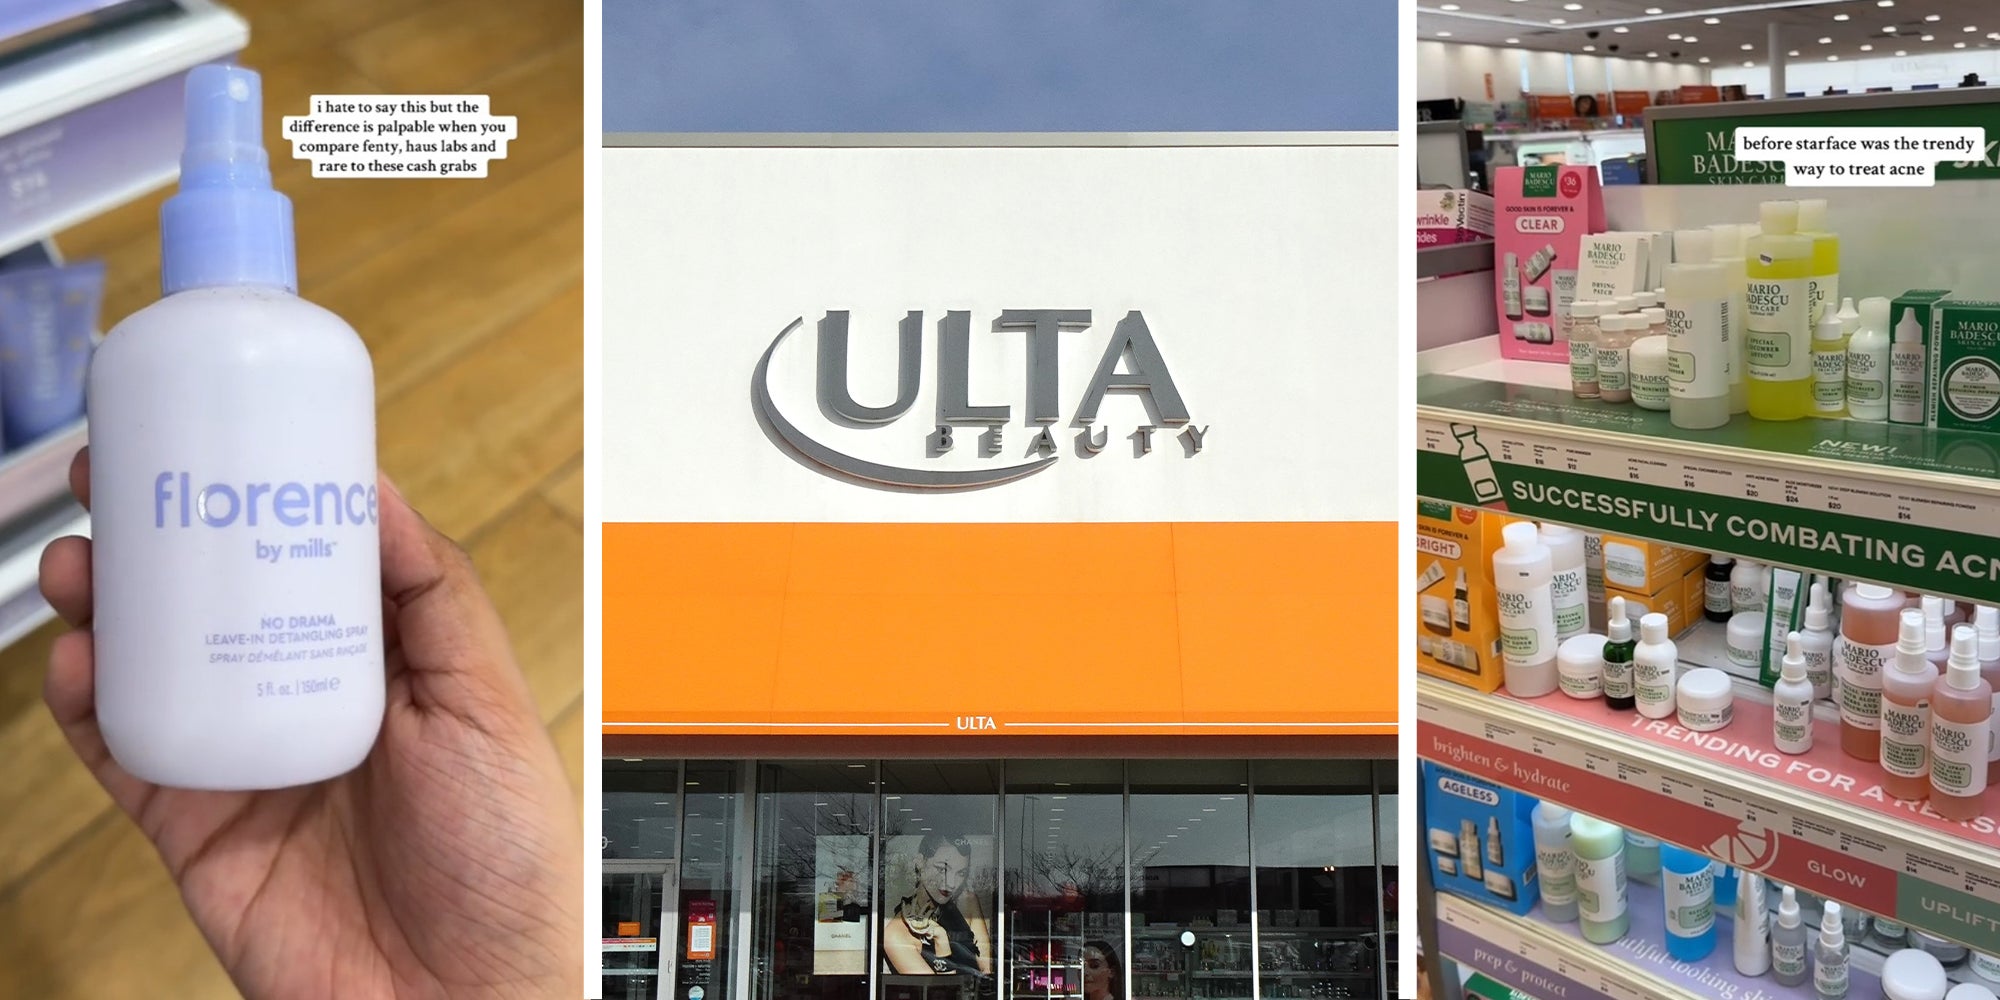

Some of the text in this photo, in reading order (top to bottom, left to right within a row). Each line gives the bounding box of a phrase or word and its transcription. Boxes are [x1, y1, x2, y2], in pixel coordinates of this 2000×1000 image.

[1692, 154, 1785, 174] BADESC
[1521, 219, 1558, 231] CLEAR
[1593, 243, 1622, 252] MARIO
[1588, 251, 1625, 261] BADESCU
[1593, 288, 1613, 296] PATCH
[1747, 294, 1789, 306] ADESCU
[1958, 322, 1998, 332] MARIO
[1894, 353, 1921, 361] MARIO
[817, 309, 1191, 425] ULTA
[930, 425, 1209, 455] BEAUTY
[1819, 439, 1898, 454] NEW!
[155, 471, 377, 529] florence
[1438, 528, 1463, 540] FOREVER
[1511, 480, 1718, 532] SUCCESSFULLY
[1726, 514, 1926, 568] COMBATING
[1935, 549, 2000, 582] ACN
[255, 540, 282, 563] by
[1552, 572, 1576, 581] ARIO
[260, 614, 336, 630] NO DRAMA
[205, 625, 368, 646] LEAVE-IN DETANGLING SPRAY
[208, 653, 245, 664] SPRAY
[247, 650, 308, 663] DÉMÊLANT
[310, 647, 334, 659] SANS
[1843, 642, 1880, 658] MARIO
[257, 683, 264, 697] 5
[956, 716, 998, 730] ULTA
[1884, 713, 1925, 729] BADESCU
[1887, 709, 1920, 723] MARIO
[1934, 722, 1966, 739] MARIO
[1433, 736, 1491, 769] brighten
[1494, 757, 1509, 772] &
[1513, 762, 1571, 793] hydrate
[1630, 714, 1778, 769] TRENDING
[1786, 759, 1856, 795] FOR
[1859, 785, 1886, 803] A
[1443, 780, 1493, 801] AGELESS
[1807, 859, 1867, 888] GLOW
[1474, 948, 1567, 998] prep & protect
[1616, 937, 1739, 1000] uthful-looking
